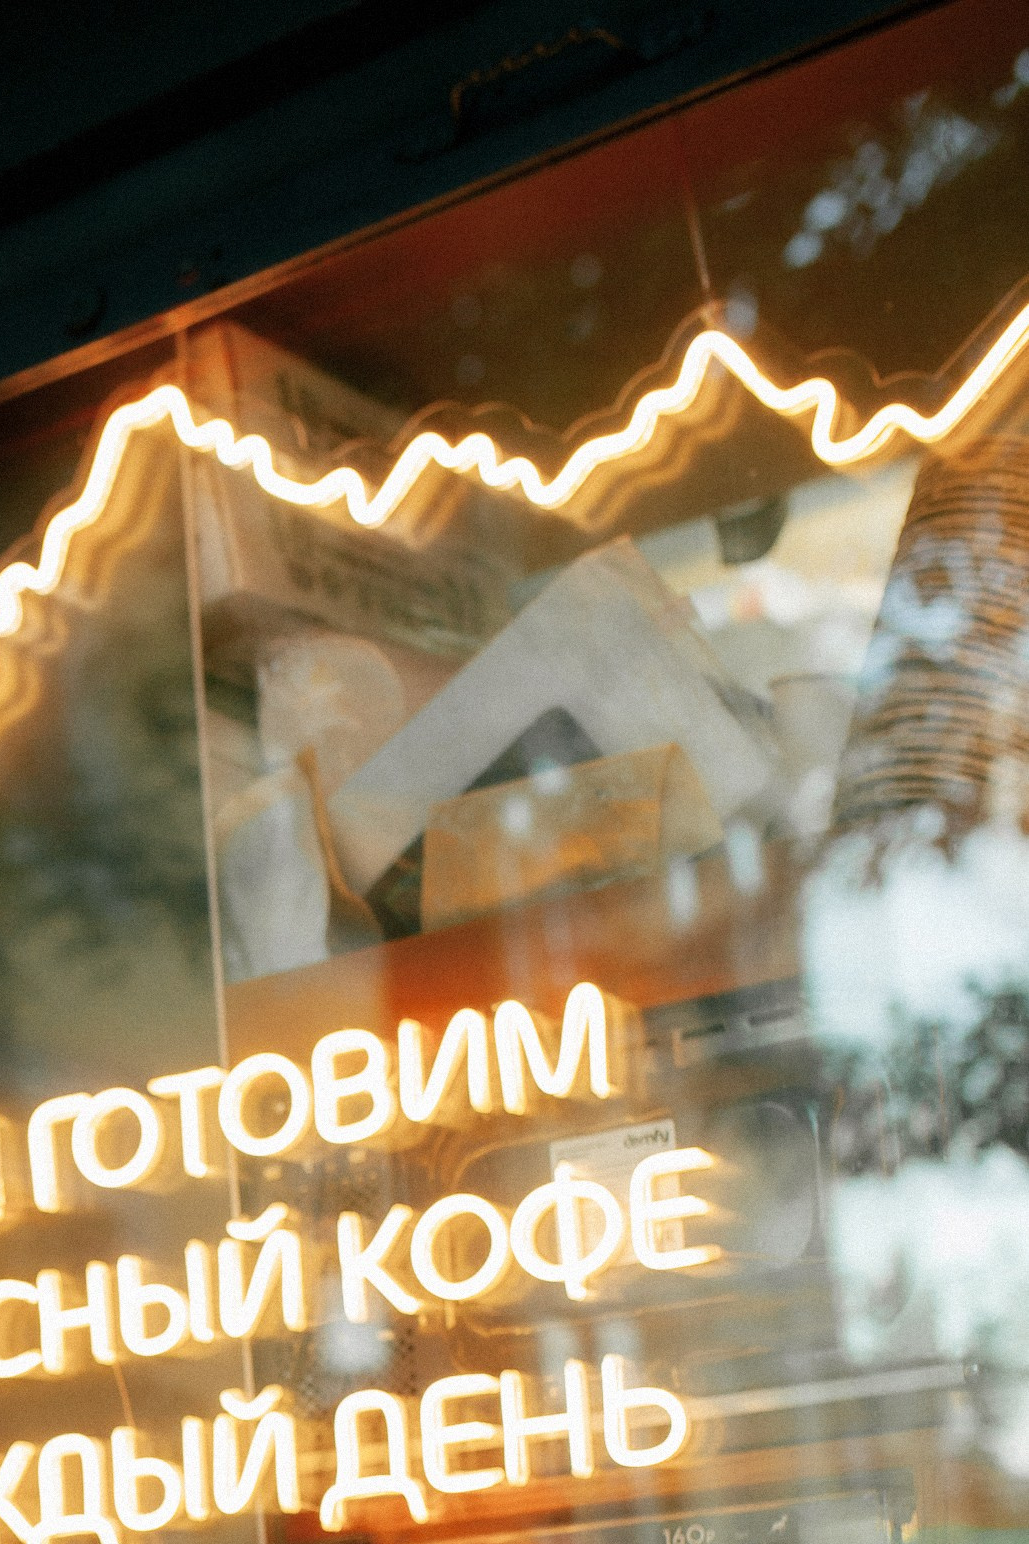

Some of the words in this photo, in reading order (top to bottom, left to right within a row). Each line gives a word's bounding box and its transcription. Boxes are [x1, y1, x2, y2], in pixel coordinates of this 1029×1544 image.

[26, 981, 613, 1212] ГОТОВИМ
[333, 1147, 720, 1324] КОФЕ
[319, 1352, 688, 1532] ДЕНЬ
